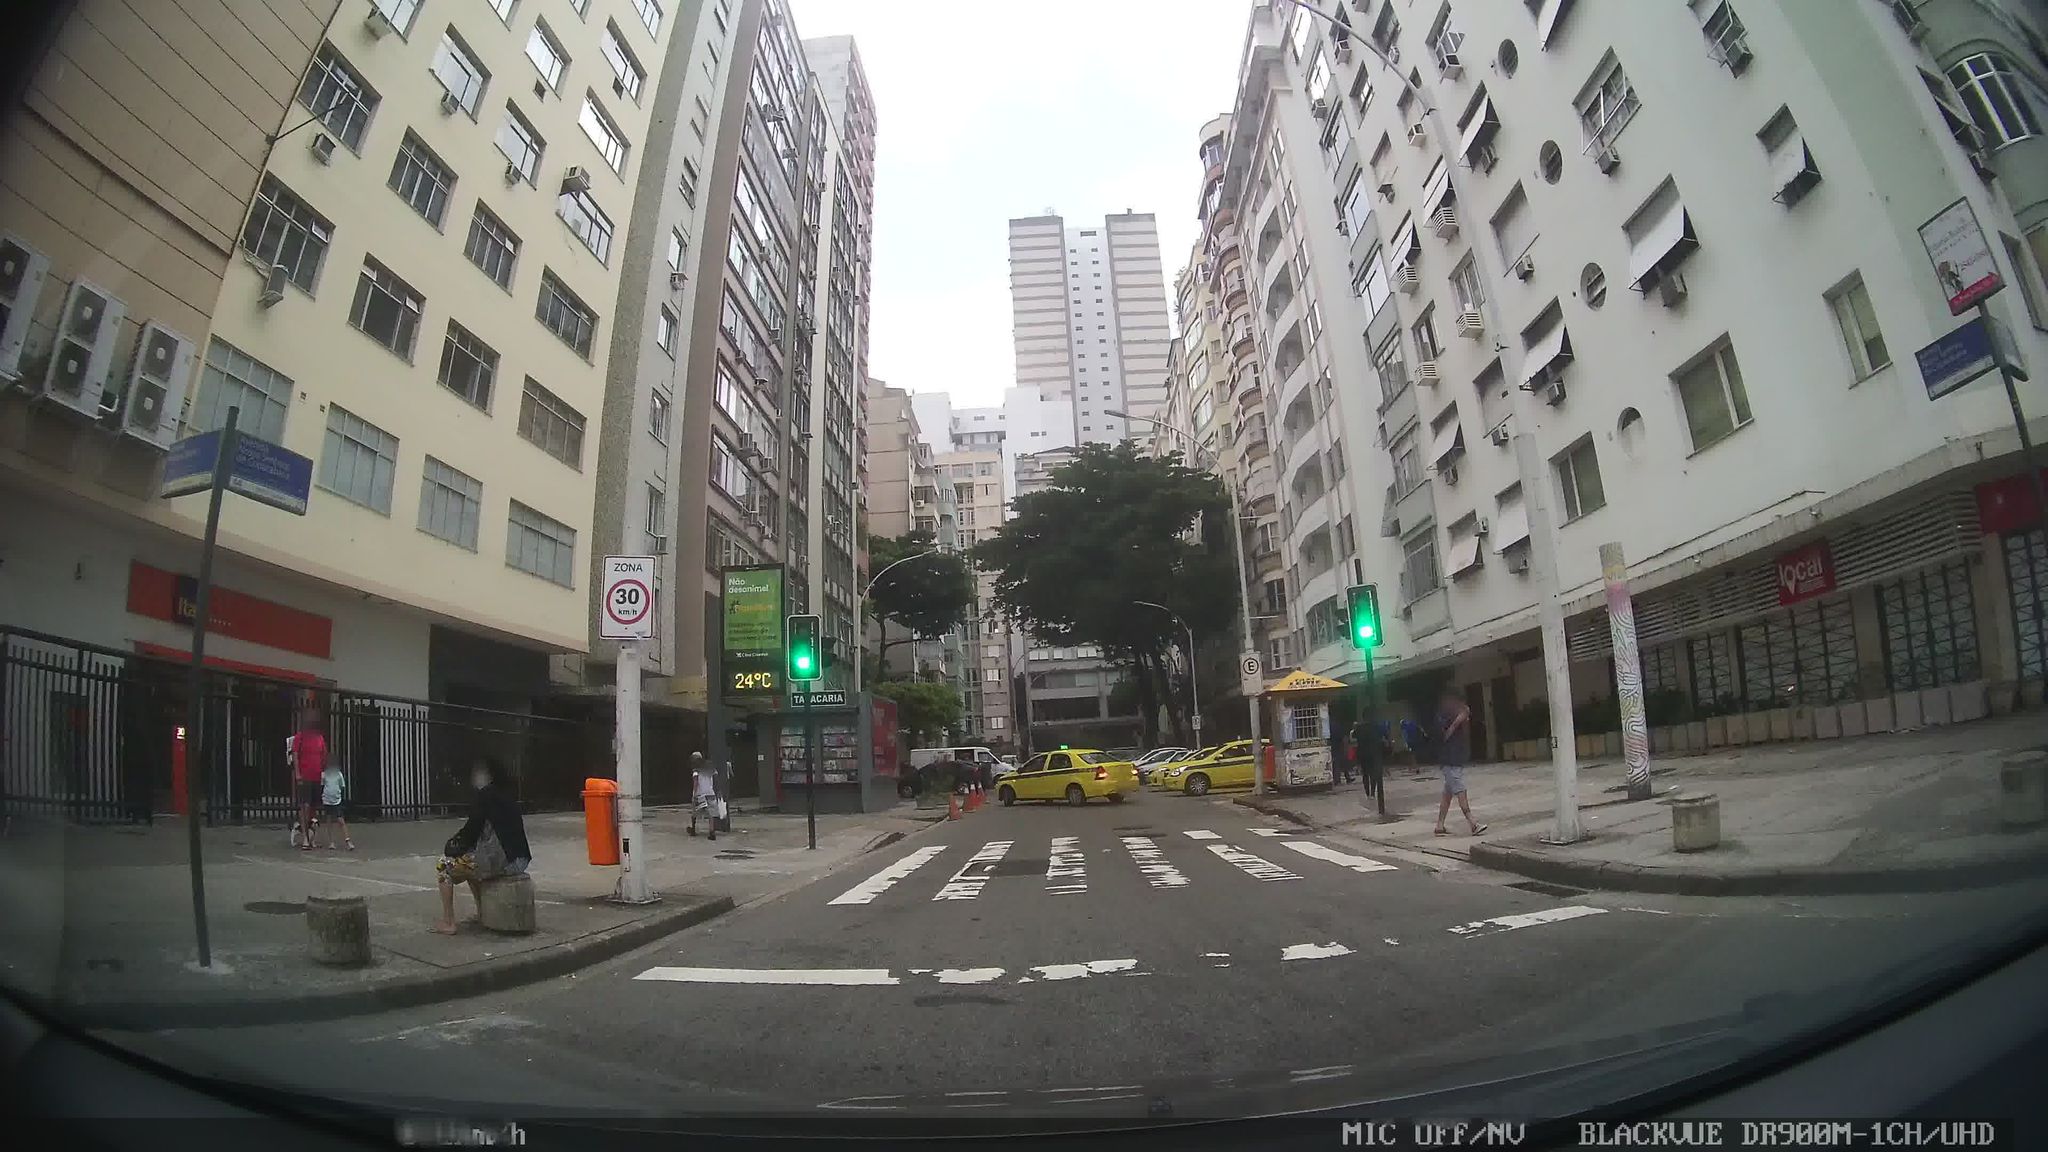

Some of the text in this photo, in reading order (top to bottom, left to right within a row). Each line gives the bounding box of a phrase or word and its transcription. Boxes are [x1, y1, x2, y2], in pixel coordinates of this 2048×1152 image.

[614, 563, 643, 572] ZONA
[1779, 557, 1823, 595] local
[729, 577, 746, 586] Não
[615, 588, 640, 605] 30
[179, 596, 197, 618] Ita
[735, 672, 772, 689] 24°C
[793, 694, 844, 704] TAACARIA
